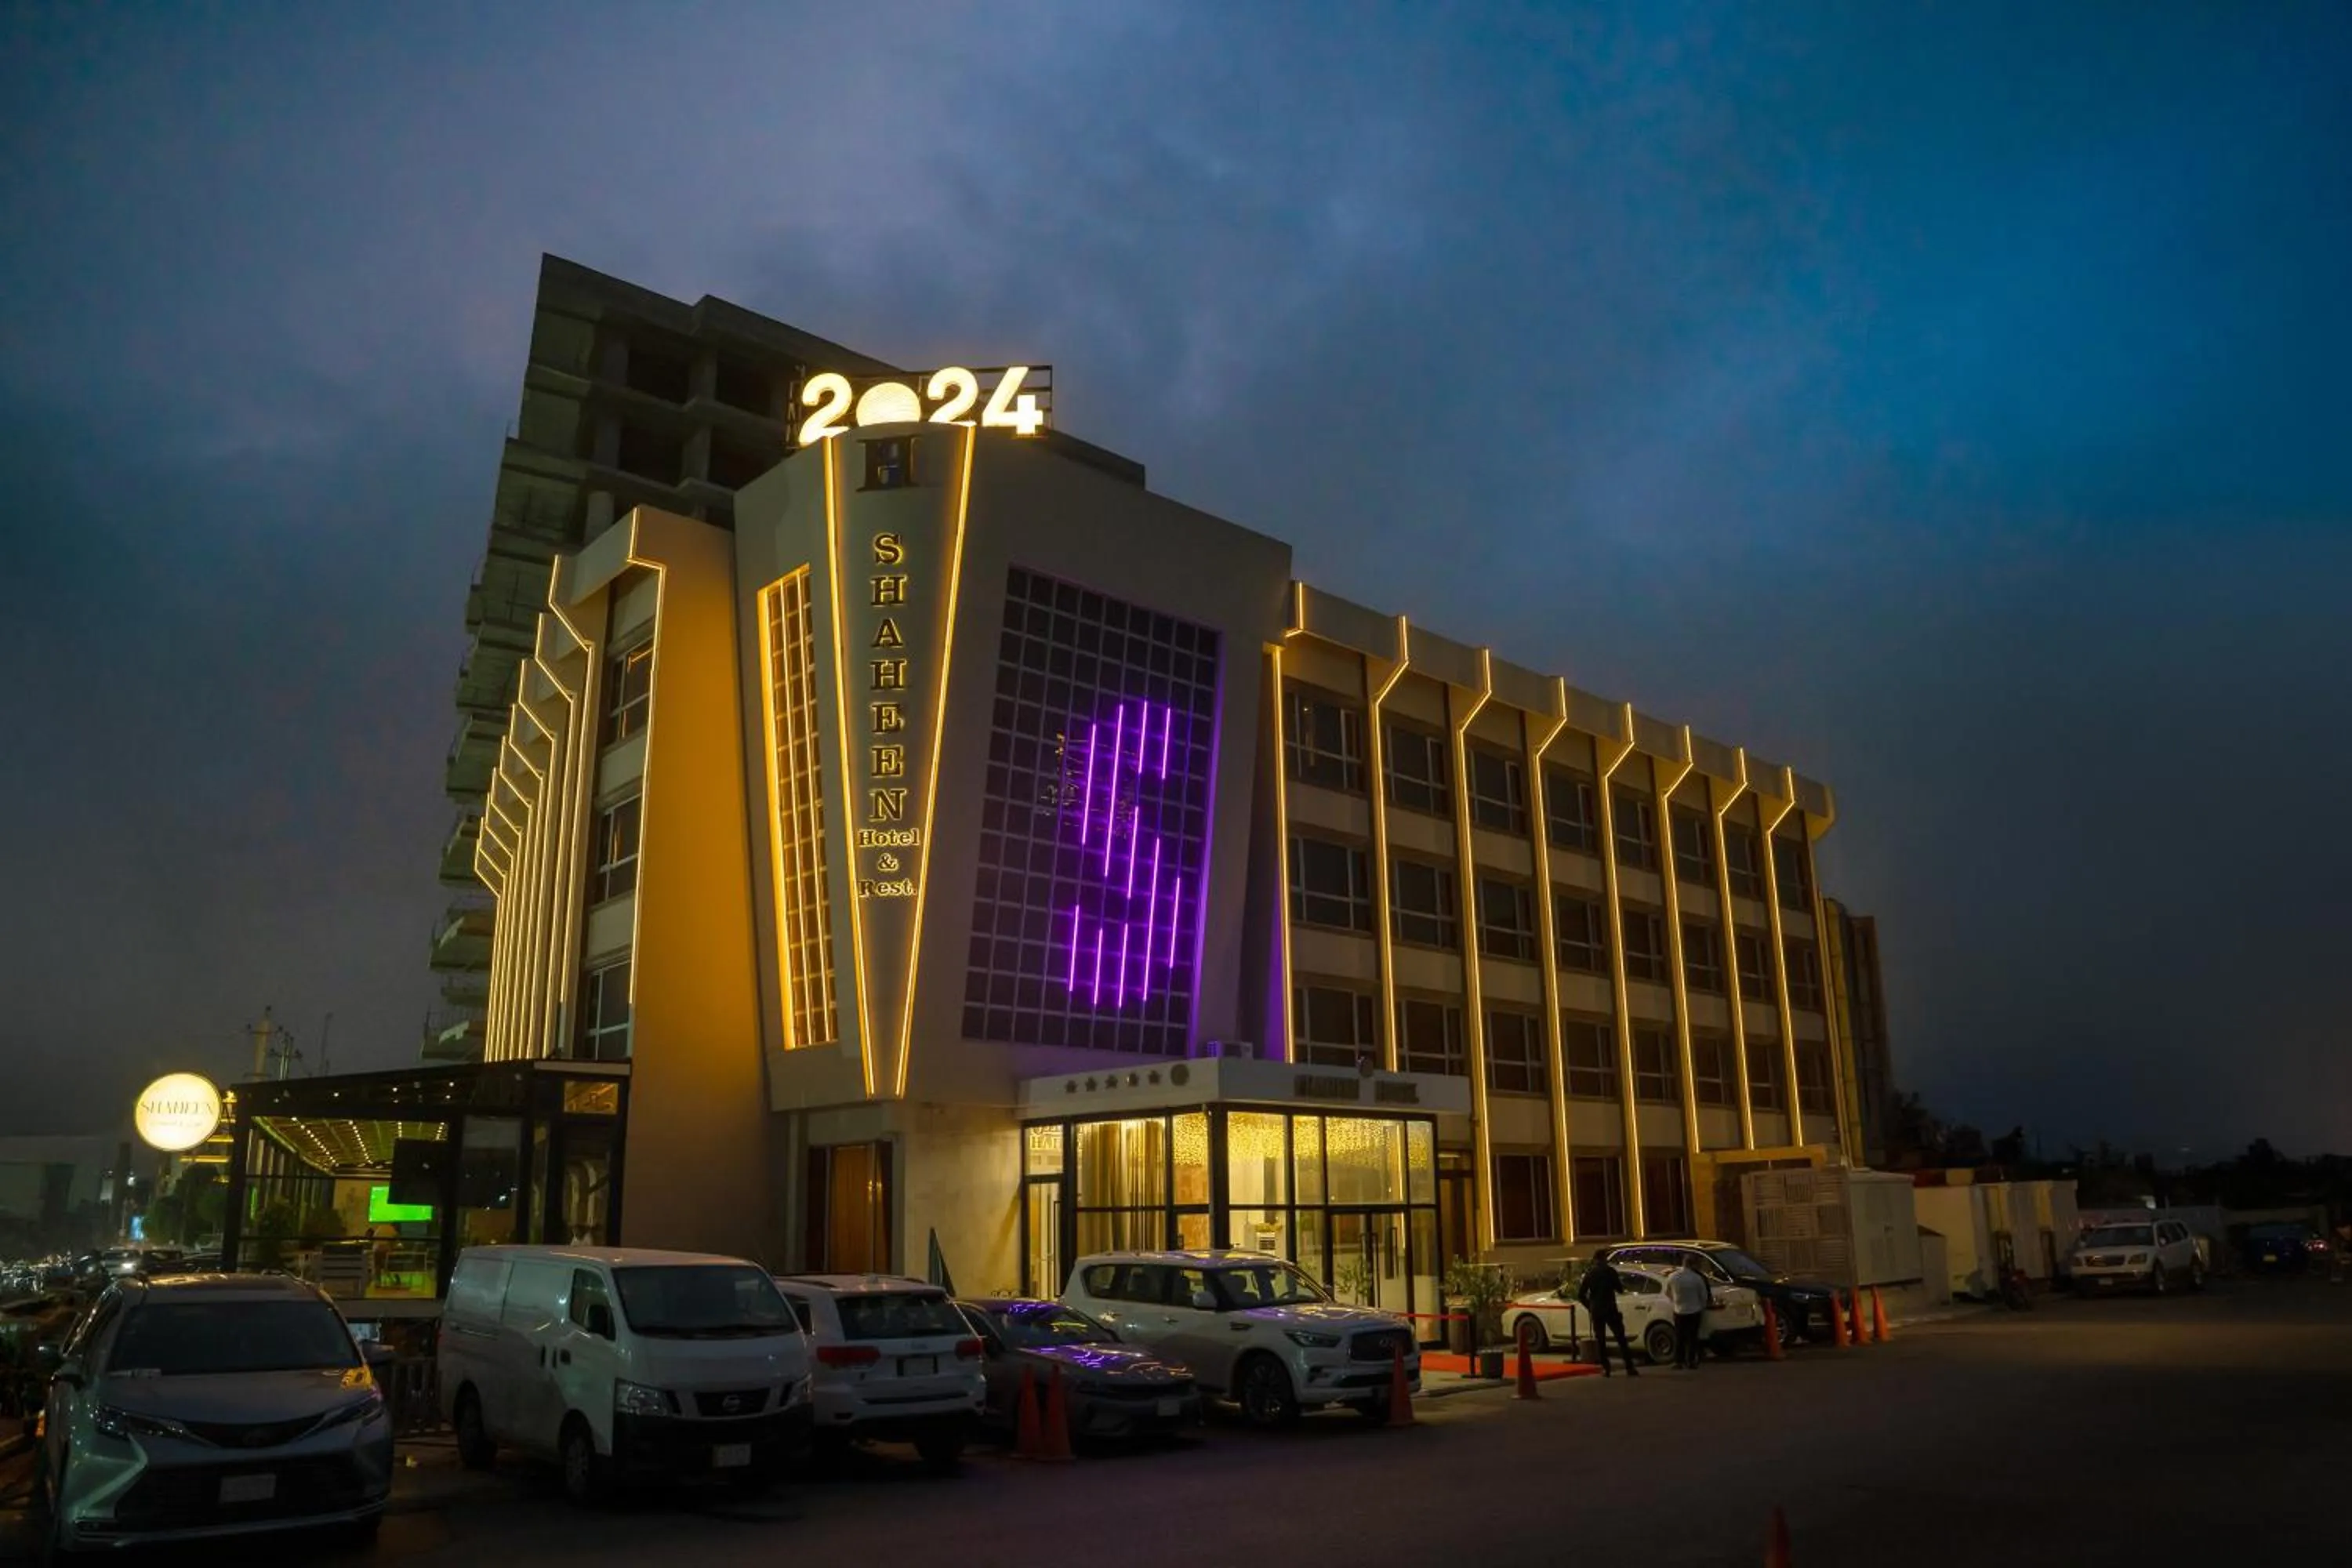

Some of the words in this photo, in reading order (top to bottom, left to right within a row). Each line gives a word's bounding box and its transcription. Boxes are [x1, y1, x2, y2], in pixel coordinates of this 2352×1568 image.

[798, 366, 1044, 447] 2024
[869, 532, 907, 822] SHAHEEN
[858, 828, 920, 848] Hotel
[877, 853, 899, 871] &
